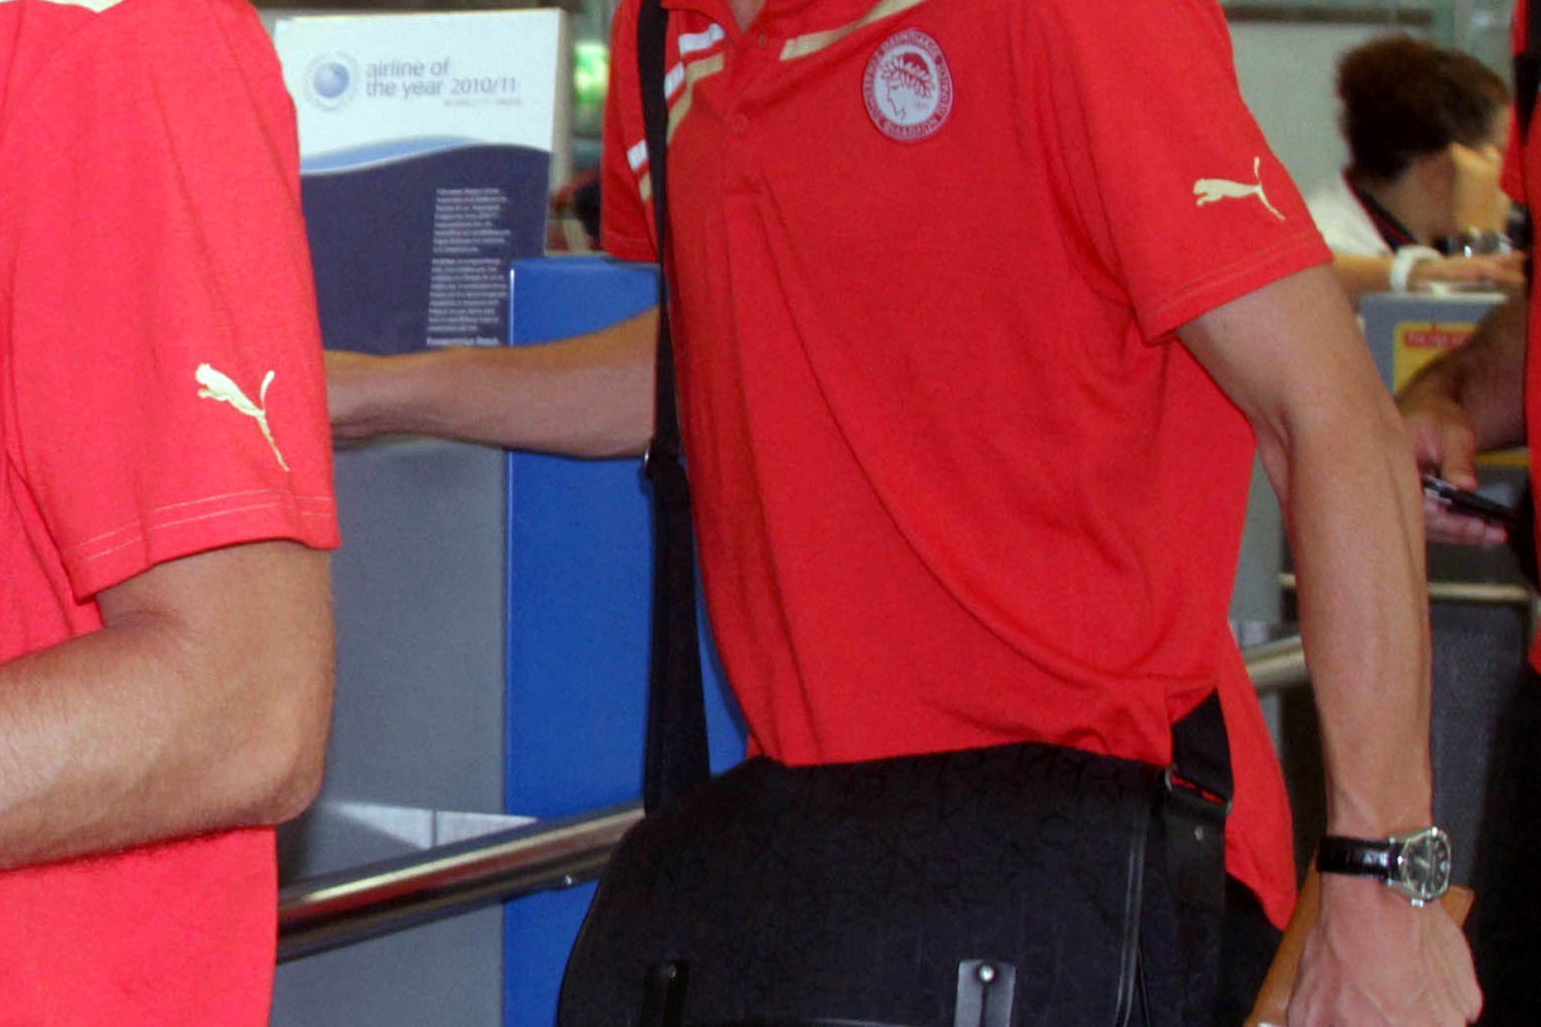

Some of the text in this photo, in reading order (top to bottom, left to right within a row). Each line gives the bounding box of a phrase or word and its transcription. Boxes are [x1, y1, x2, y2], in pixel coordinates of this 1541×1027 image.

[365, 55, 452, 78] airline of
[365, 75, 518, 100] the year 2010/11
